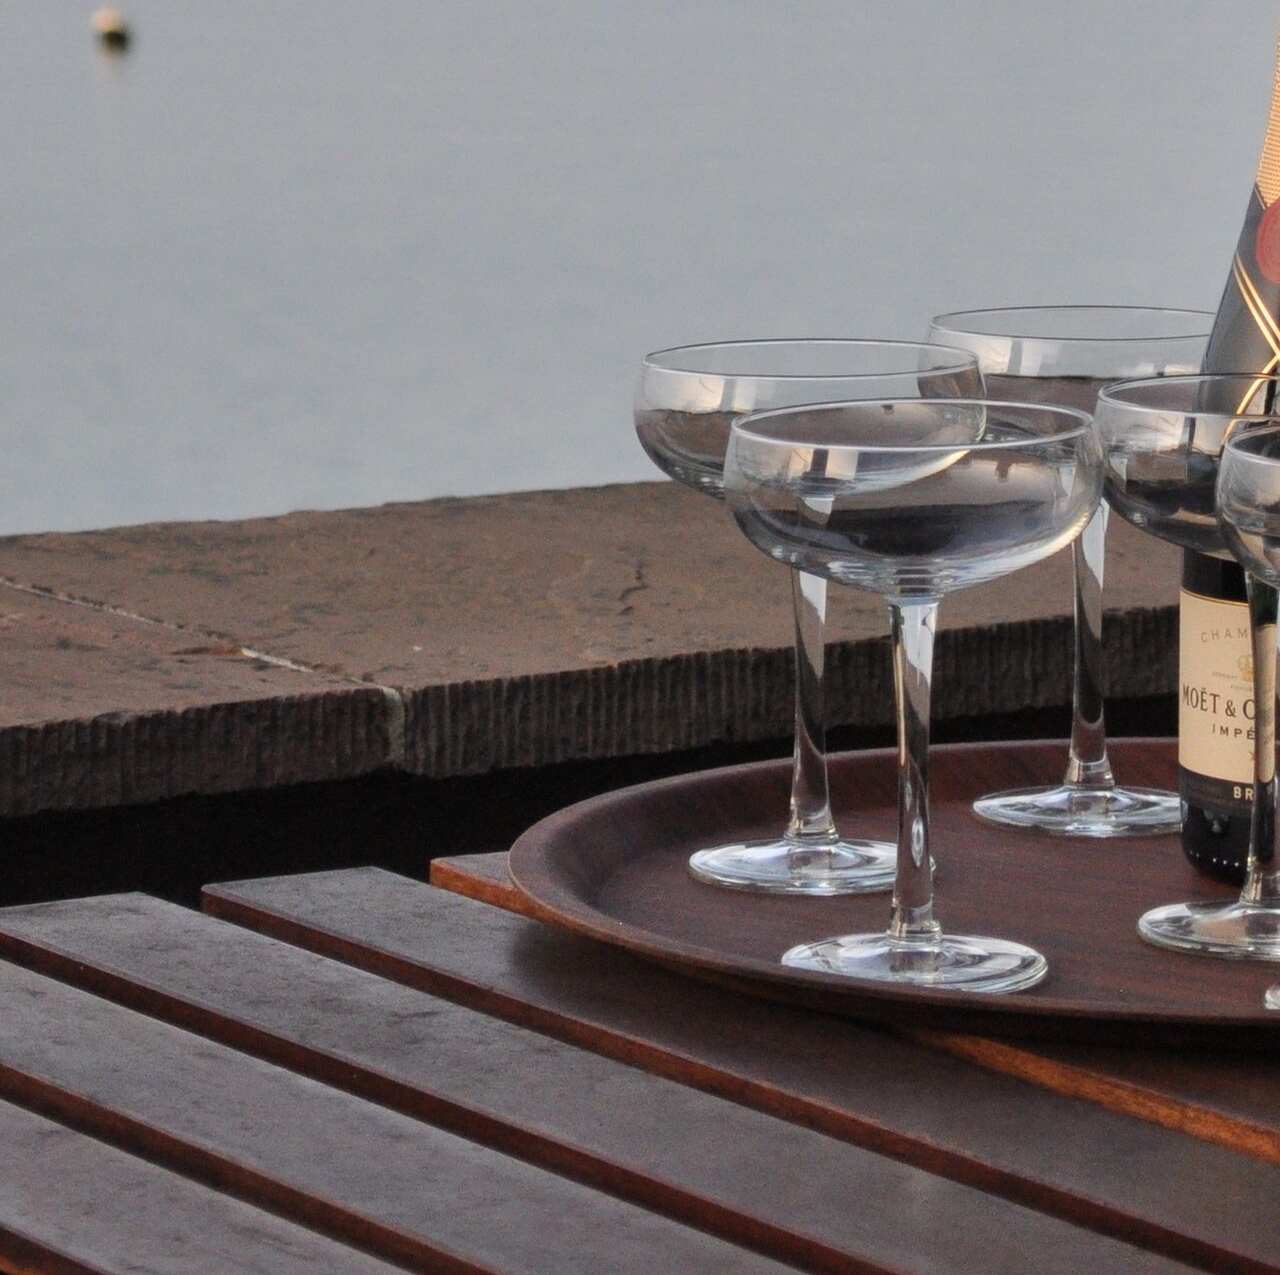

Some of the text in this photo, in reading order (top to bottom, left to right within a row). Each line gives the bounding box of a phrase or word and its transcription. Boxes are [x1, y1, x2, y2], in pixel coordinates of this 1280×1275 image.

[1182, 684, 1221, 715] MOËT
[1224, 699, 1238, 718] &
[1233, 786, 1254, 801] BR
